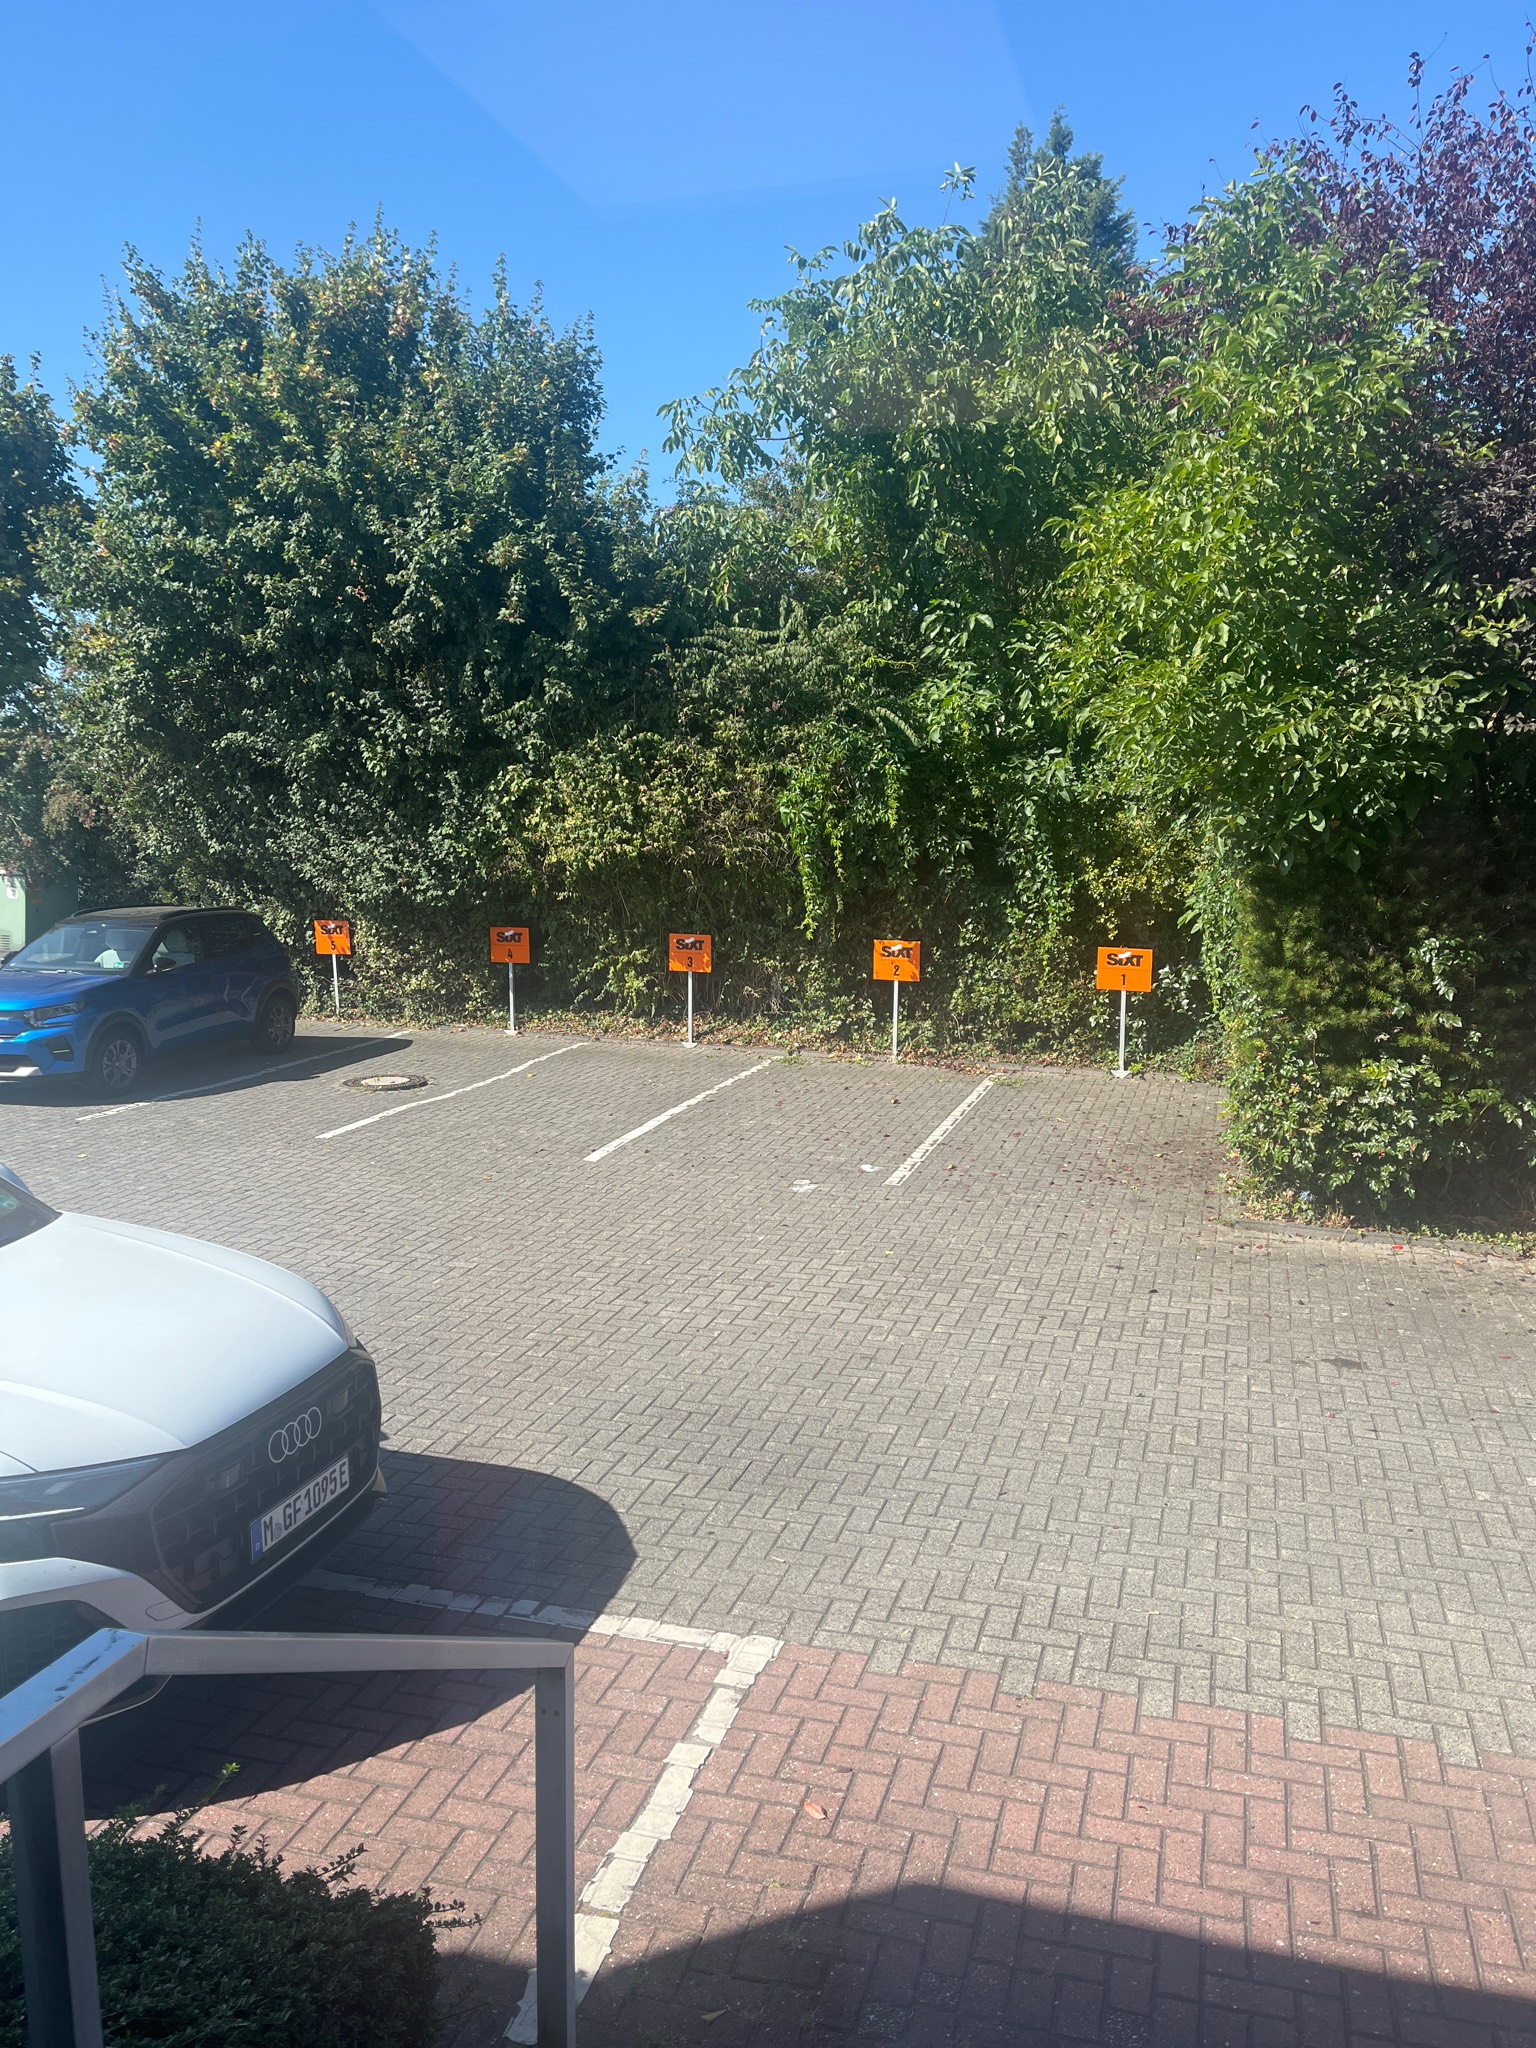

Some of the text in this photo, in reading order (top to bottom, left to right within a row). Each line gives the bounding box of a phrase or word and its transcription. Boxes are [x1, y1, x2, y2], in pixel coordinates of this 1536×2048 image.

[331, 939, 336, 950] 5
[507, 949, 513, 959] 4
[687, 957, 692, 967] 3
[894, 965, 899, 976] 2
[1121, 974, 1126, 985] 1
[264, 1516, 273, 1547] M
